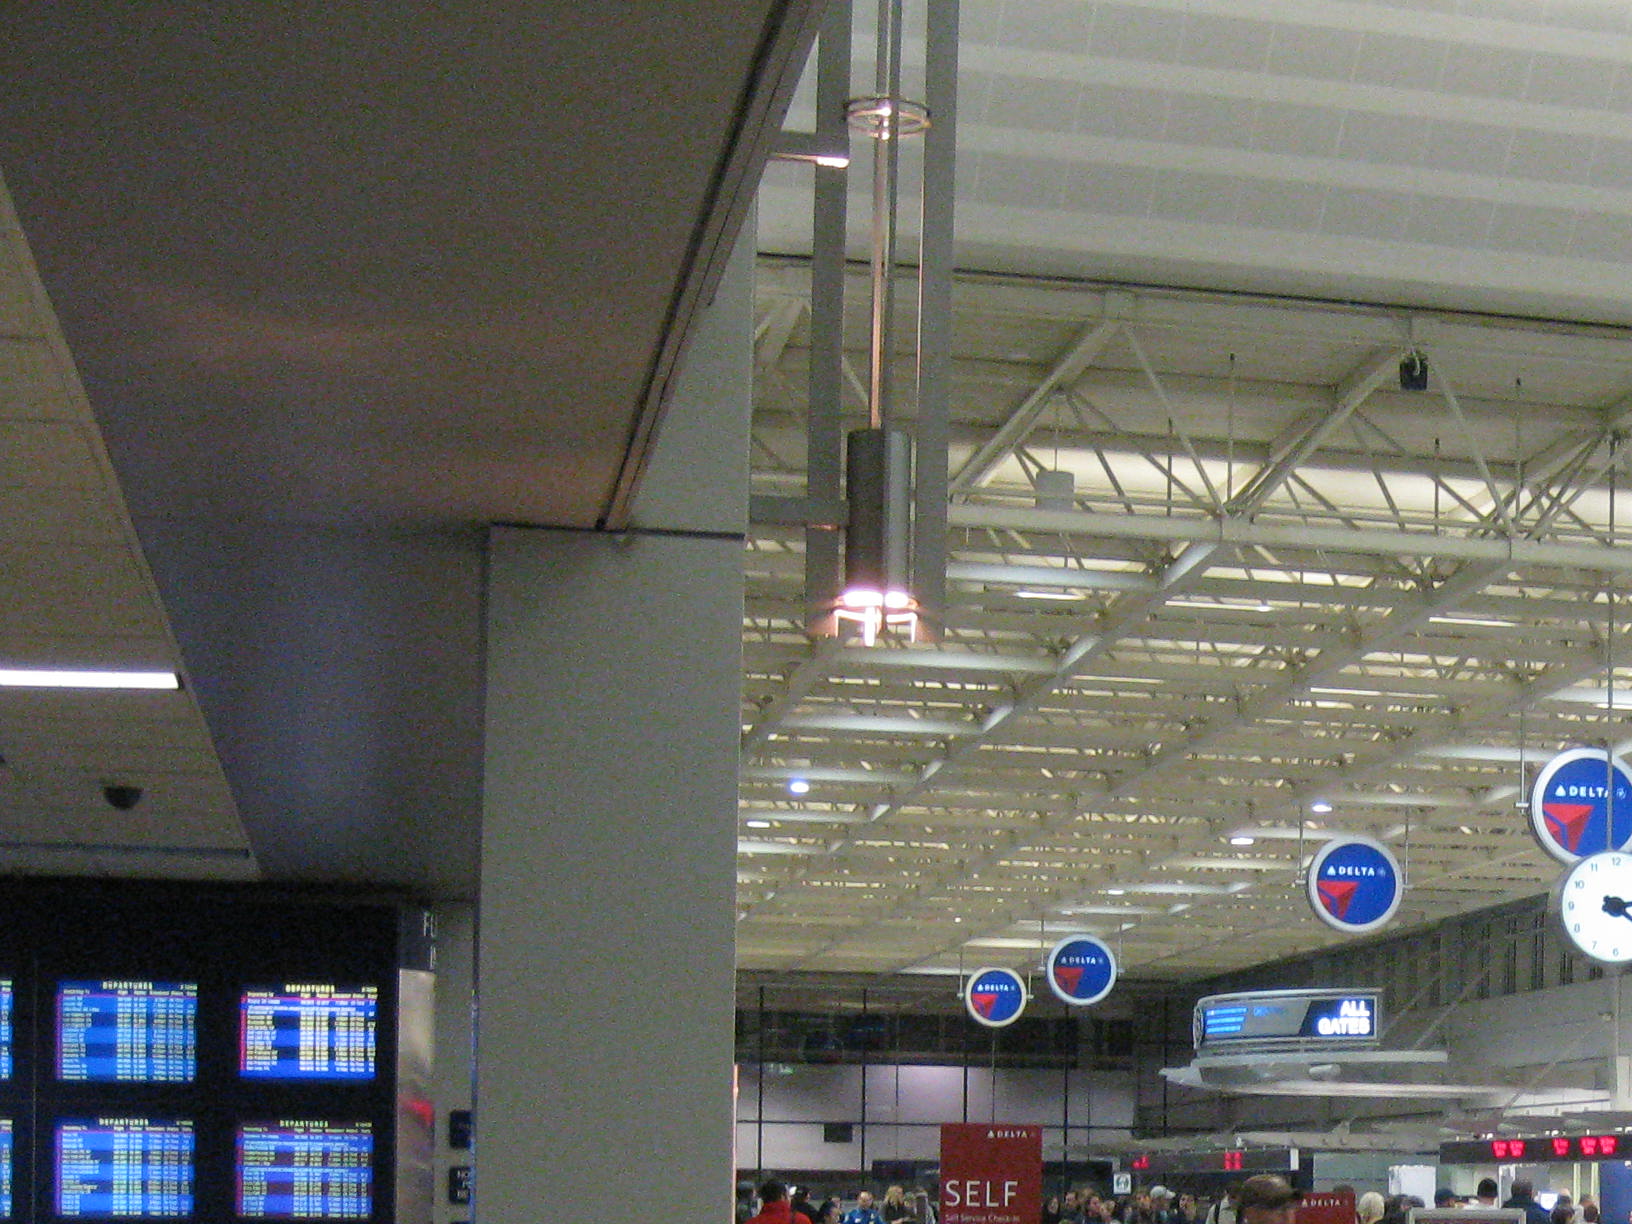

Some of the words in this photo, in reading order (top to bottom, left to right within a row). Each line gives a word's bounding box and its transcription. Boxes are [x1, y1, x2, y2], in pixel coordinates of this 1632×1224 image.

[1612, 857, 1621, 866] 12
[1338, 866, 1375, 876] DELTA
[1590, 863, 1598, 872] 11
[1574, 880, 1584, 889] 10
[1568, 901, 1575, 910] 9
[1574, 923, 1581, 933] 8
[1592, 941, 1597, 950] 7
[1612, 948, 1618, 956] 6
[103, 982, 153, 990] DEPARTURES
[285, 984, 335, 993] DEPARTURES
[985, 984, 1008, 992] DELTA
[1340, 1001, 1370, 1017] ALL
[1318, 1017, 1370, 1035] GATES
[99, 1118, 149, 1126] DEPARTURES
[280, 1120, 329, 1128] DEPARTURES
[997, 1130, 1027, 1138] DELTA
[945, 1180, 1018, 1207] SELF
[1311, 1199, 1341, 1207] DELTA
[960, 1214, 986, 1222] Service
